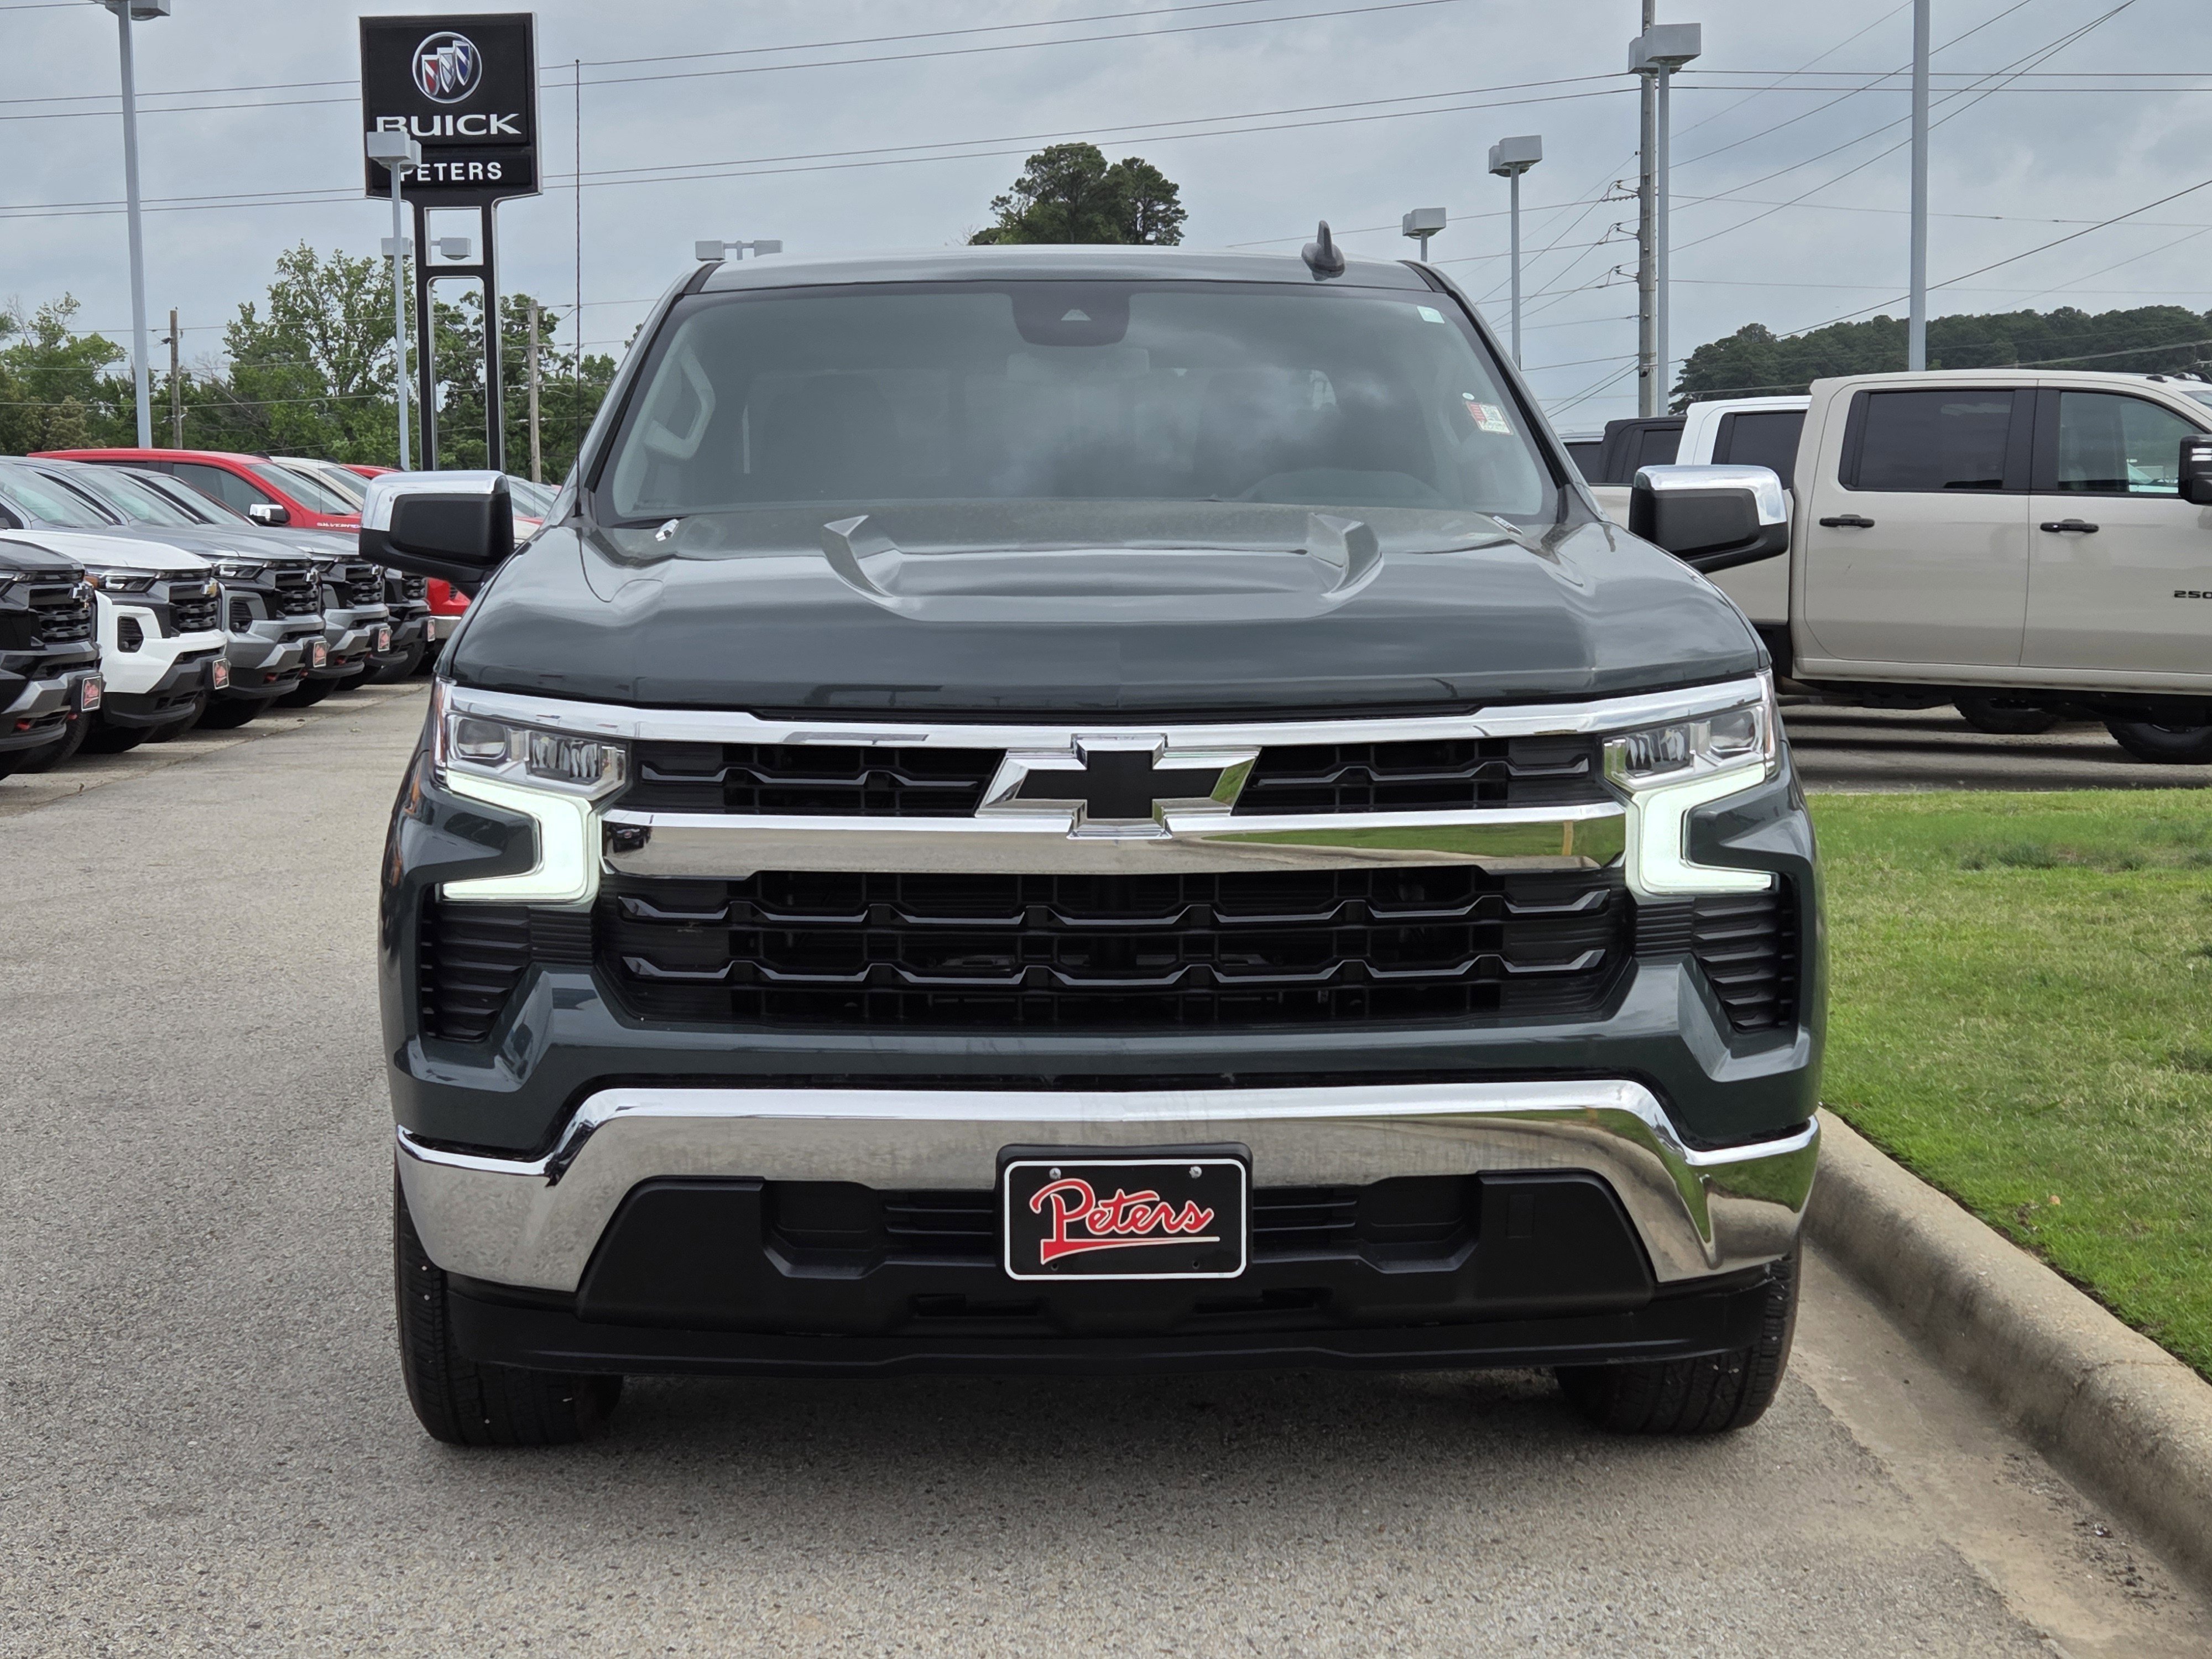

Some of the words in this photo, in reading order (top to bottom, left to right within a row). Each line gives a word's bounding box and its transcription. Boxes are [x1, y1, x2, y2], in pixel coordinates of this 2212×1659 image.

[377, 114, 521, 136] BUICK
[2174, 590, 2212, 599] 250
[1029, 1178, 1220, 1265] Peters
